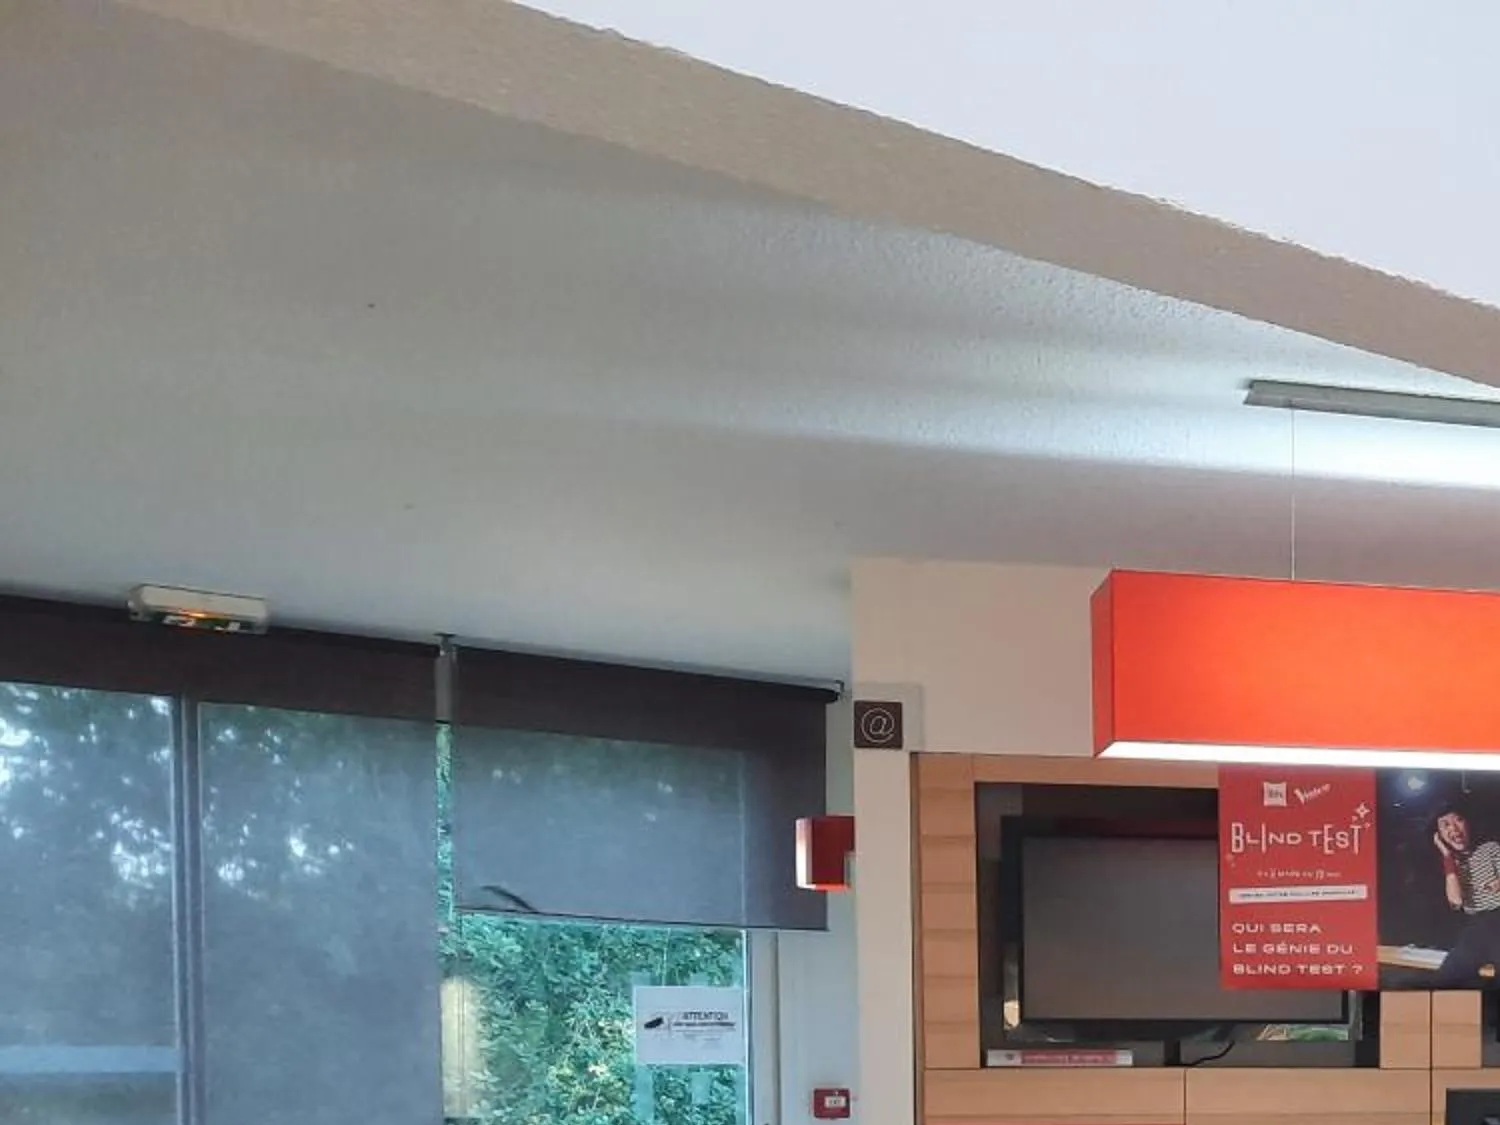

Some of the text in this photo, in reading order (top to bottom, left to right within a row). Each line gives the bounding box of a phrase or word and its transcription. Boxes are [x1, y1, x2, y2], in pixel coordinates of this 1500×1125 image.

[1231, 822, 1362, 855] BLIND TEST
[1232, 923, 1322, 934] QUI SERA
[1232, 941, 1353, 954] LE GÉNIE DU
[1232, 964, 1364, 975] BLIND TEST ?
